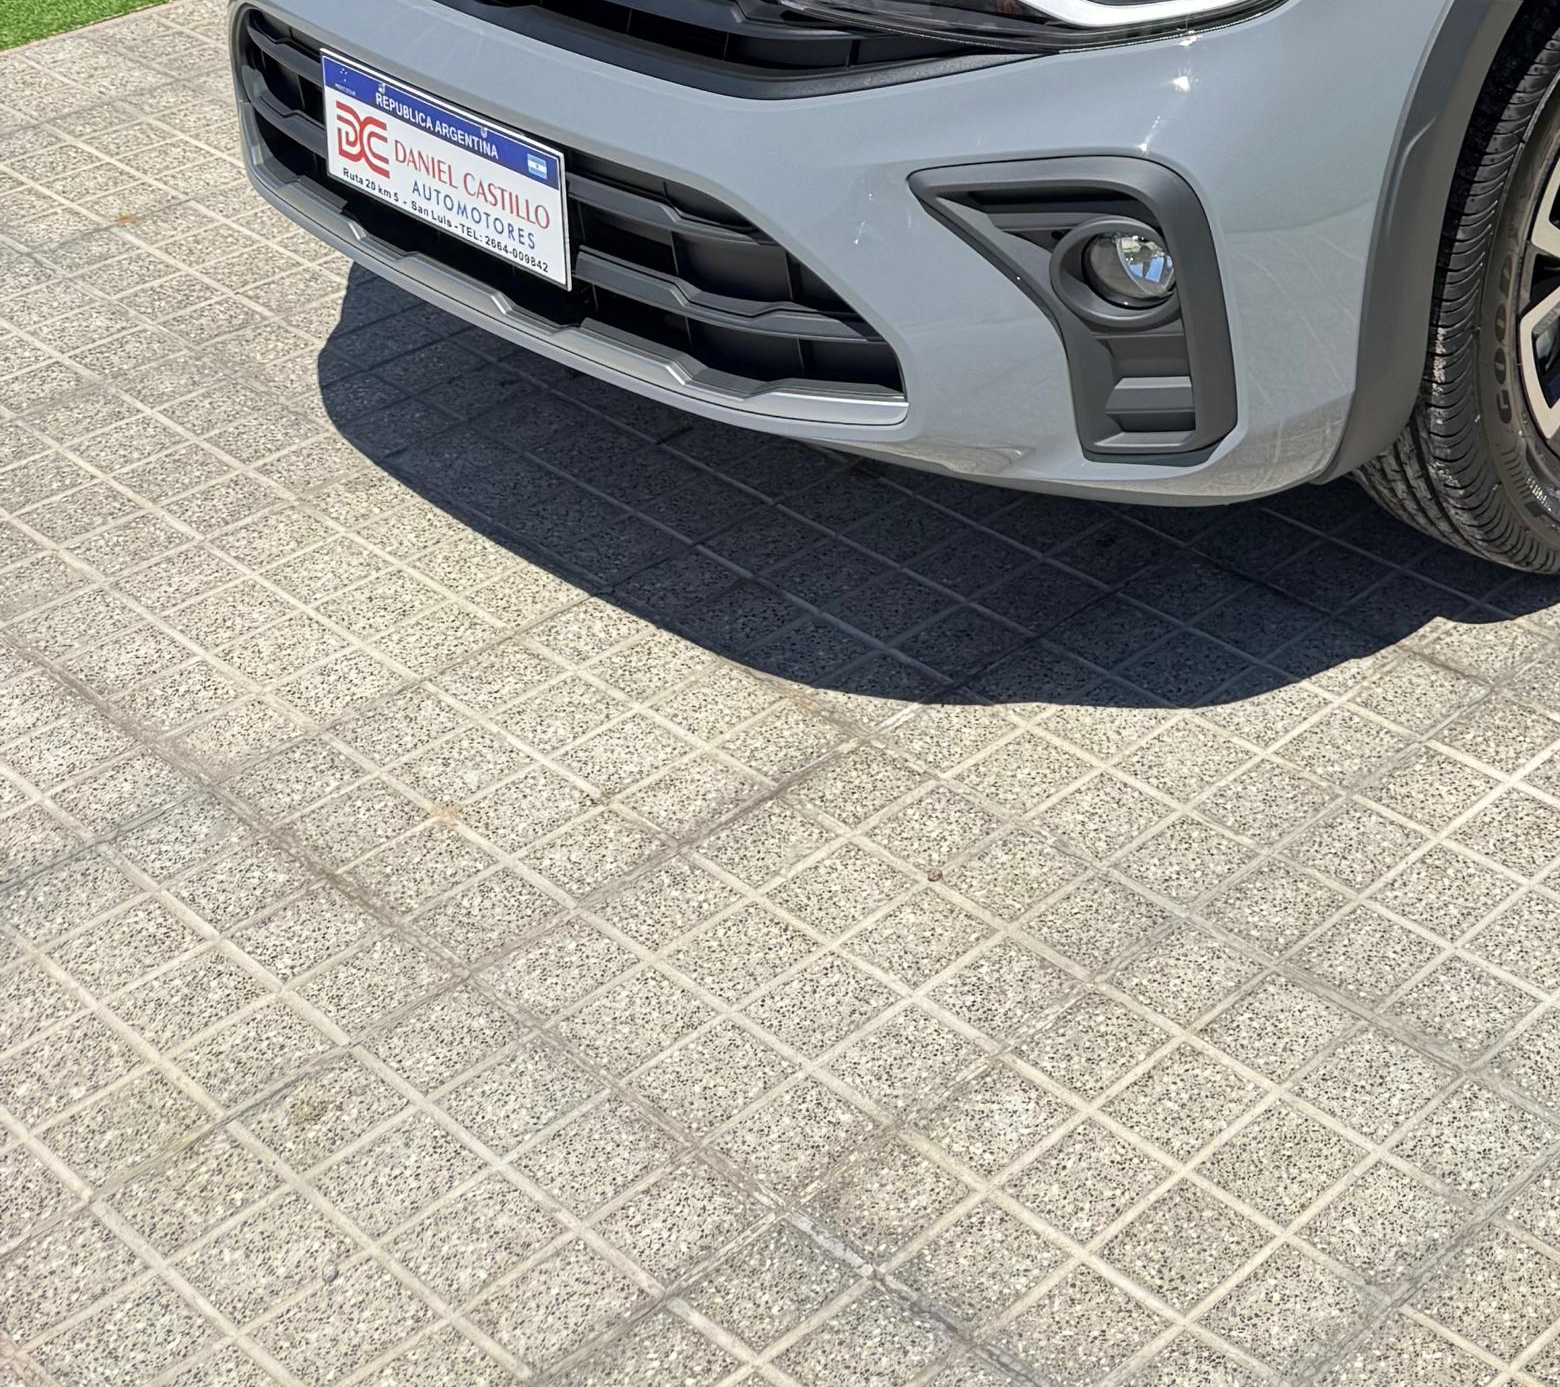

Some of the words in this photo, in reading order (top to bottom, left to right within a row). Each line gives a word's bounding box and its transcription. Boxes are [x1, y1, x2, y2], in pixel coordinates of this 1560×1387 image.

[376, 93, 433, 130] REPUBLICA
[435, 120, 499, 160] ARGENTINA
[343, 167, 364, 185] Ruta
[365, 178, 376, 191] 20
[378, 184, 392, 199] km
[394, 192, 399, 202] 5
[411, 200, 429, 217] San
[431, 210, 452, 228] Luis
[394, 139, 458, 189] DANIEL
[463, 172, 550, 229] CASTILLO
[412, 179, 536, 250] AUTOMOTORES
